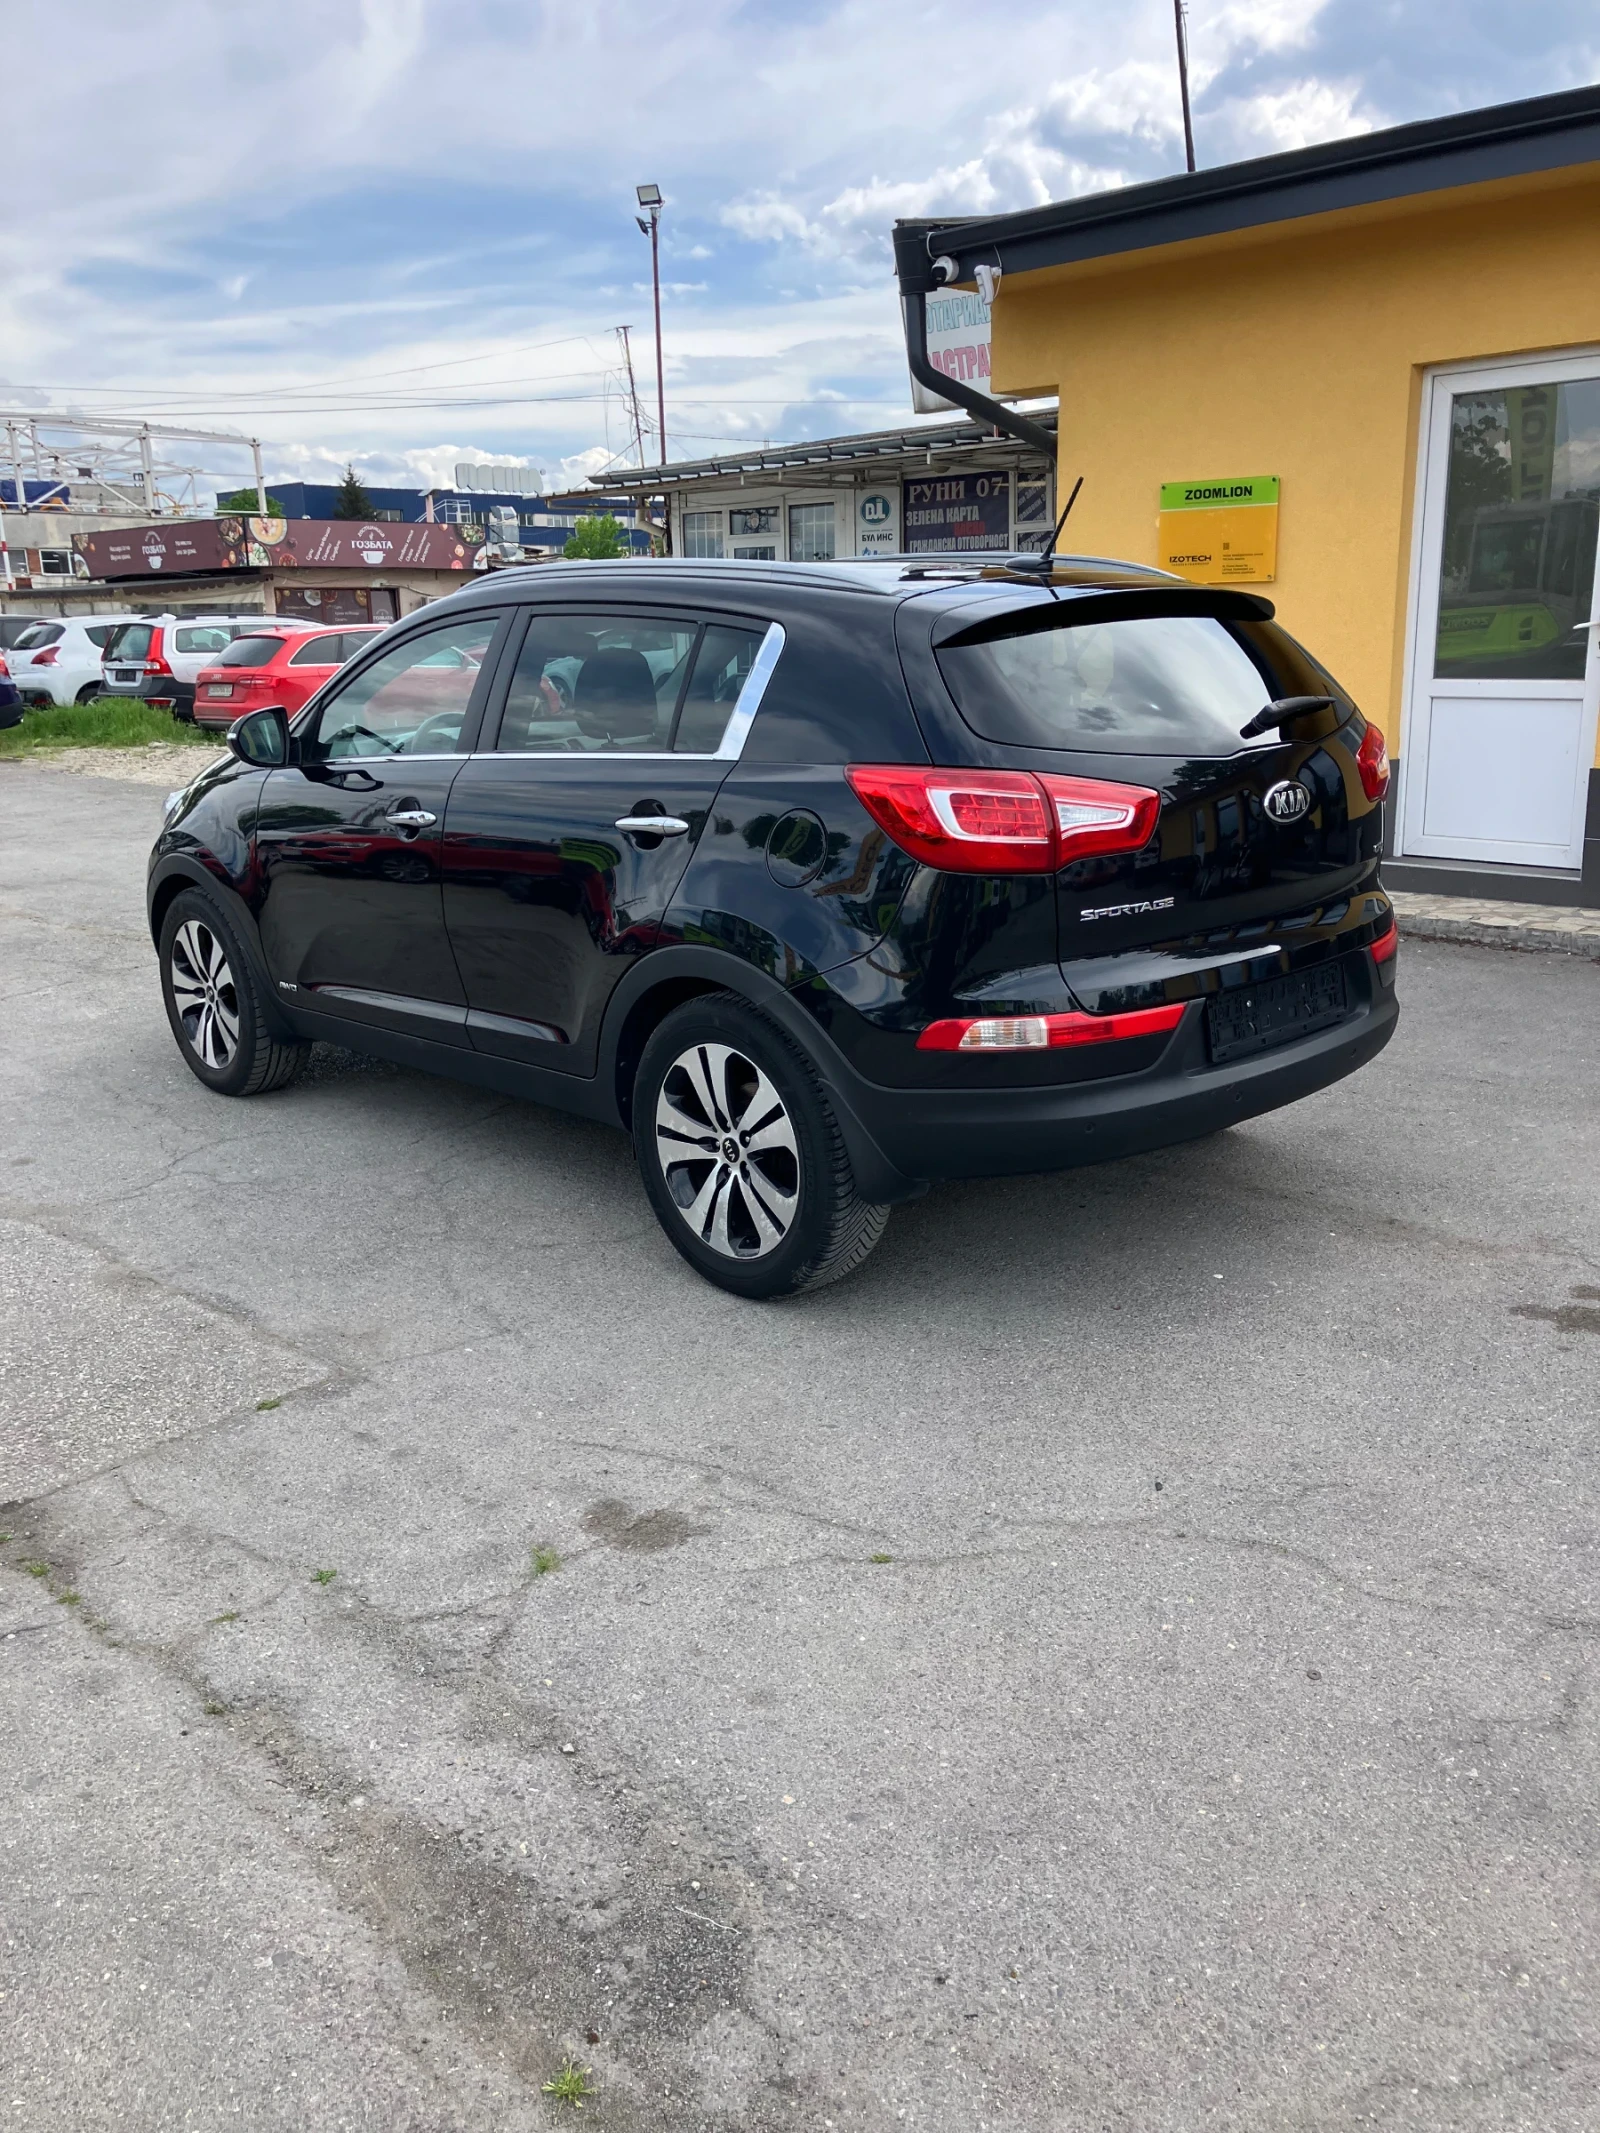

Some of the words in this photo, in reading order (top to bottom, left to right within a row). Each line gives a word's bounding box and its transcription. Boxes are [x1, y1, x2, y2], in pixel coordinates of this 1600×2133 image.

[926, 293, 991, 333] ОТАРИА
[909, 481, 965, 504] РУНИ
[976, 477, 1003, 498] 07
[1185, 486, 1253, 500] ZOOMLION
[906, 510, 944, 527] ЗЕЛЕНА
[946, 505, 980, 523] КАРТА
[351, 540, 393, 549] ГОЗБАТА
[861, 533, 876, 542] БУЛ
[876, 533, 893, 542] ИНС
[909, 538, 957, 553] ГРАЖДАНСКА
[957, 534, 1009, 550] ОТГОВОРНОСТ
[1169, 555, 1212, 563] IZOTECH
[1274, 788, 1306, 815] KIA
[1080, 897, 1174, 922] SPORTAGE
[724, 1139, 736, 1161] KIA
